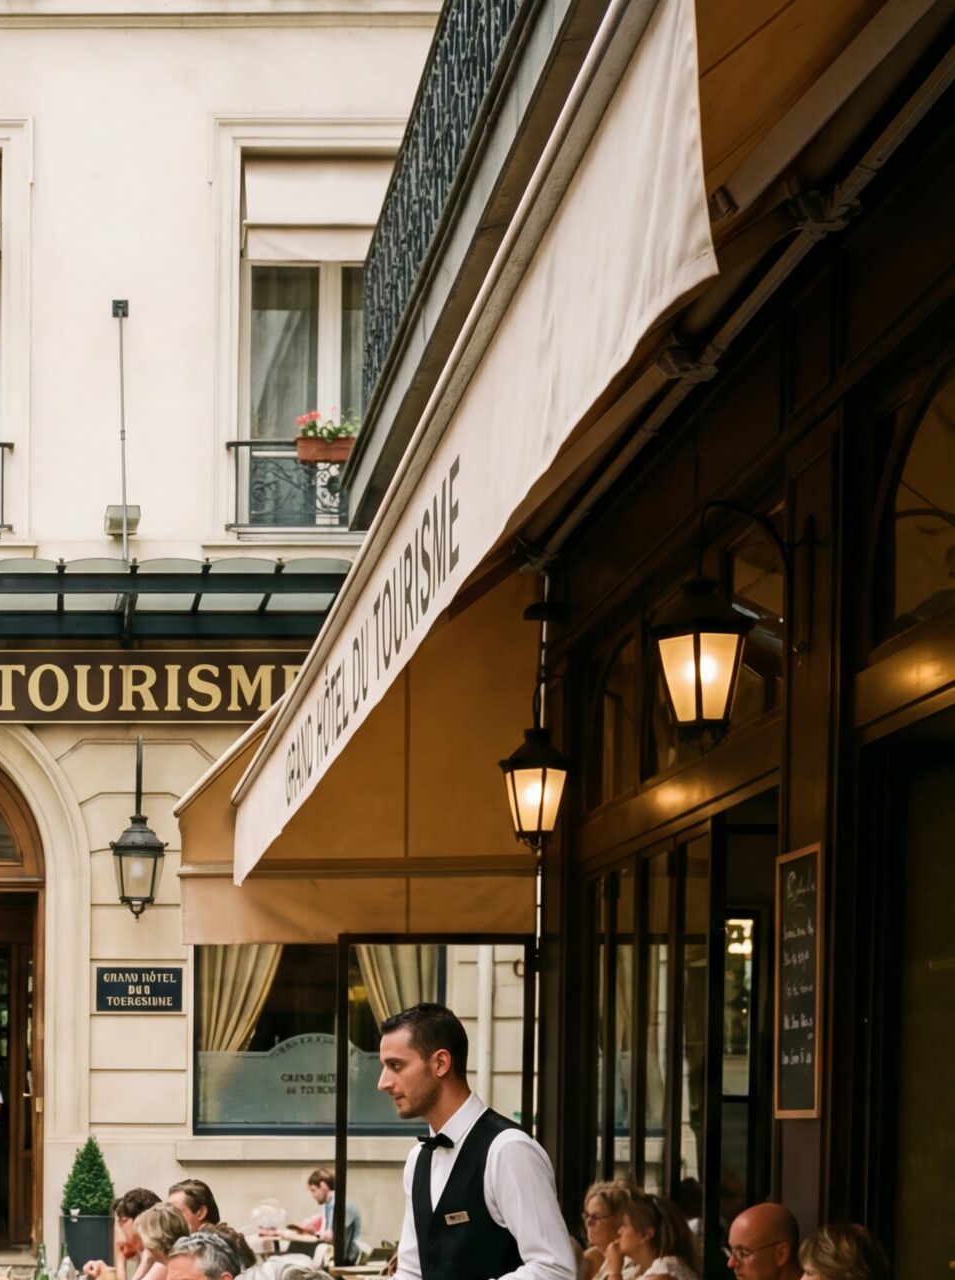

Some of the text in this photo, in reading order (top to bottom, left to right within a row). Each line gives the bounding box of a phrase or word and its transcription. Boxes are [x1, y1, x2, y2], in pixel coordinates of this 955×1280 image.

[286, 714, 314, 807] GRAND
[353, 617, 369, 714] DU
[373, 453, 460, 681] TOURISME
